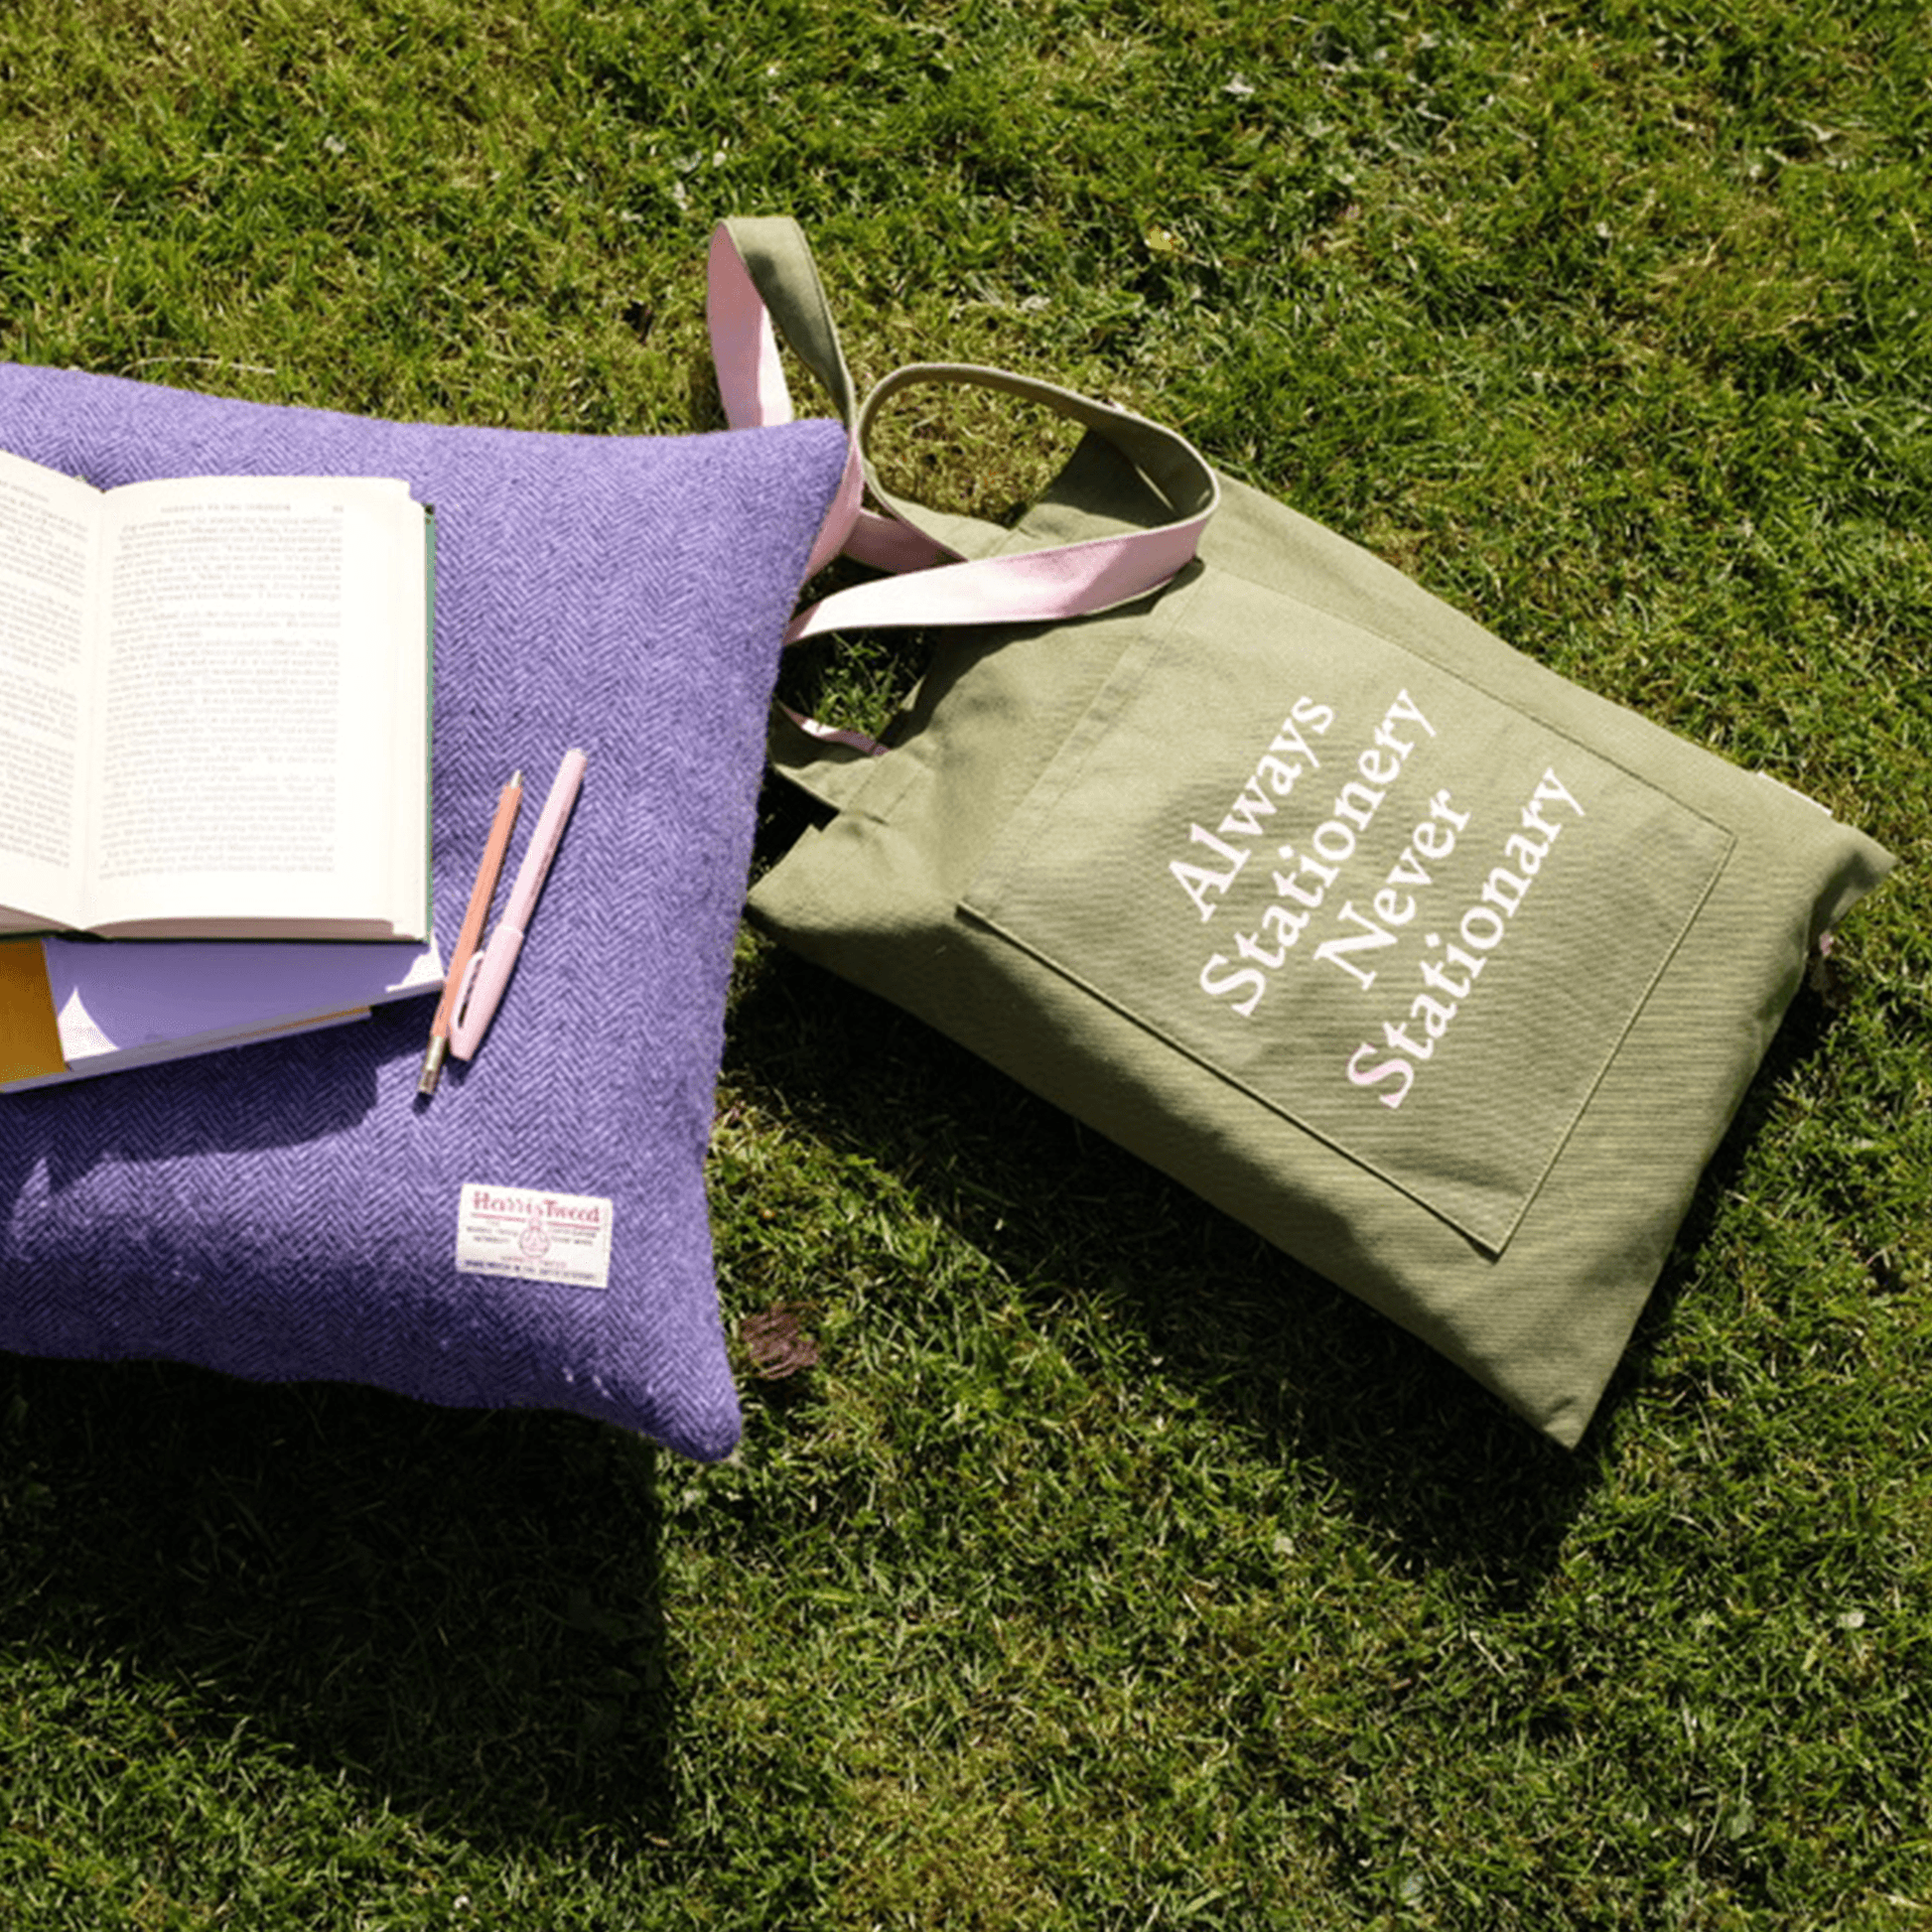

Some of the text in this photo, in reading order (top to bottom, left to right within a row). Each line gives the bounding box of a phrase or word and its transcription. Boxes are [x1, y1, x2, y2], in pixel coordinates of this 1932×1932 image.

[1169, 696, 1333, 923] Always
[1199, 688, 1437, 1018] Stationery
[1312, 787, 1471, 990] Never
[1346, 766, 1586, 1109] Stationary
[472, 1190, 600, 1224] Harris Tweed
